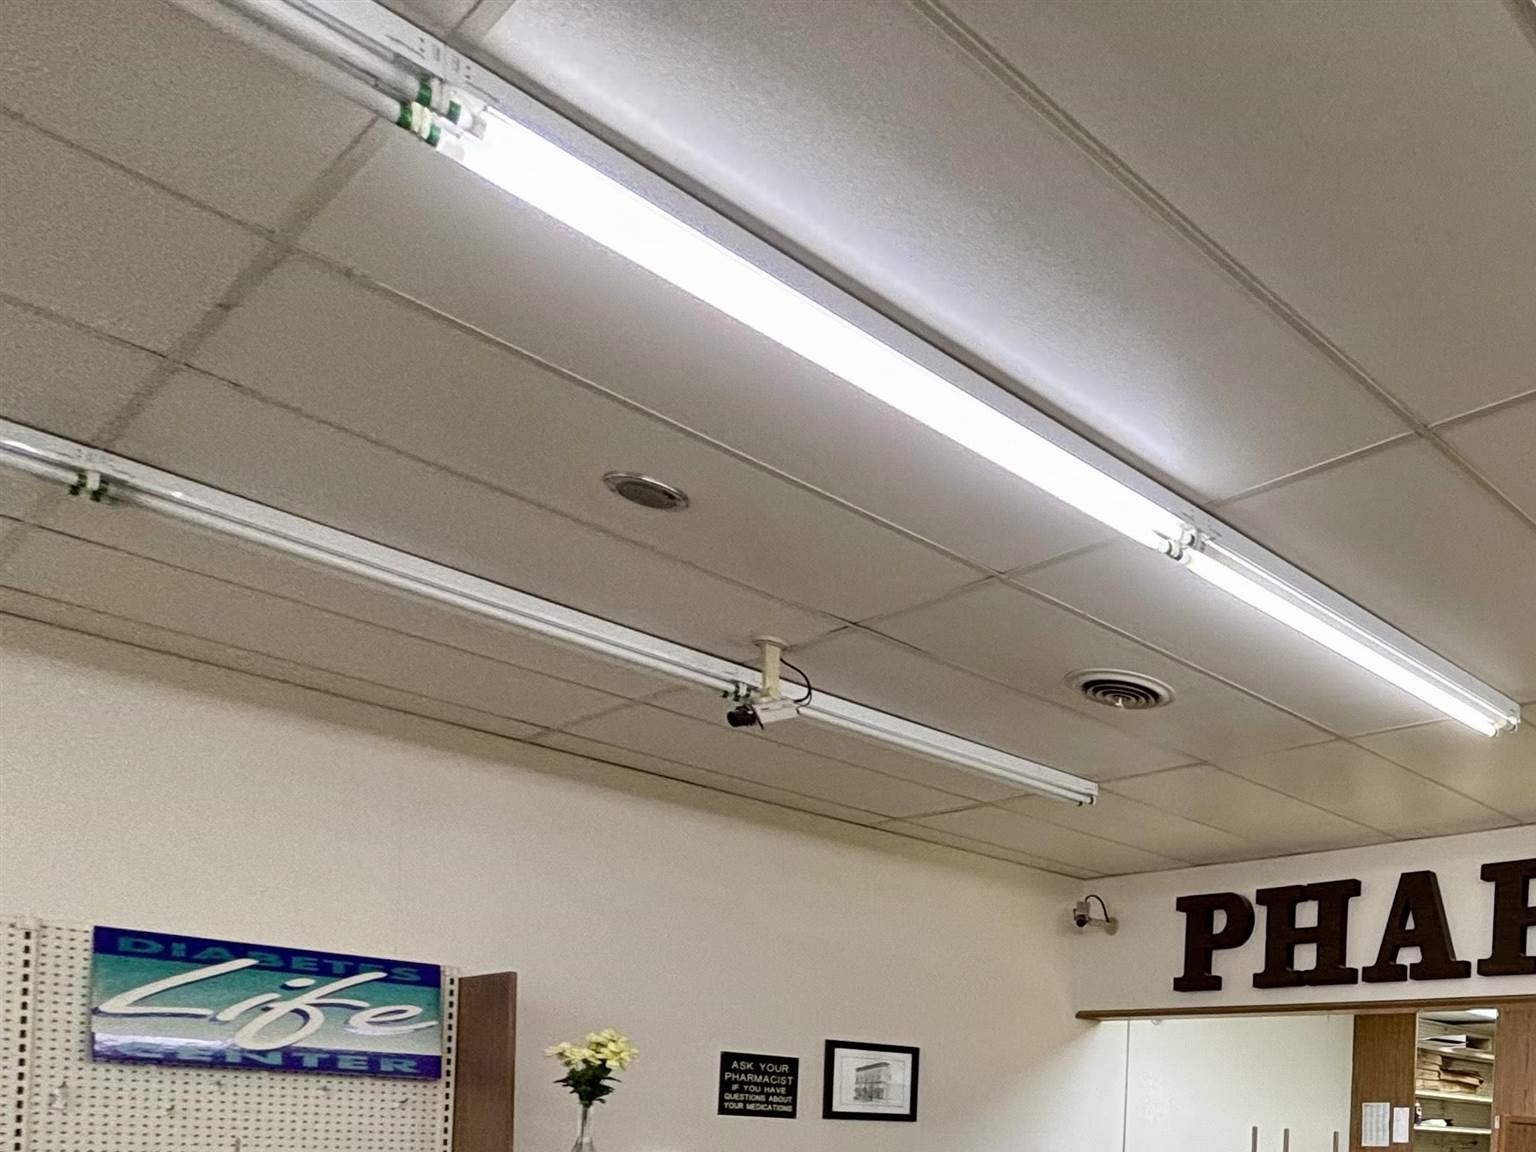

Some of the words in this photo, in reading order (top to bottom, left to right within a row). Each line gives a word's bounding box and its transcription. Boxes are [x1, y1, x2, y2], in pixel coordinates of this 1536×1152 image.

[95, 957, 440, 1052] Life
[114, 1041, 422, 1074] CENTER
[731, 1060, 754, 1070] ASK
[759, 1063, 789, 1073] YOUR
[724, 1072, 793, 1085] PHARMACIST
[743, 1085, 761, 1093] YOU
[764, 1086, 786, 1095] HAVE
[723, 1092, 766, 1102] QUESTIONS
[768, 1095, 793, 1104] ABOUT
[723, 1102, 744, 1110] YOUR
[746, 1103, 793, 1112] MEDICATIONS
